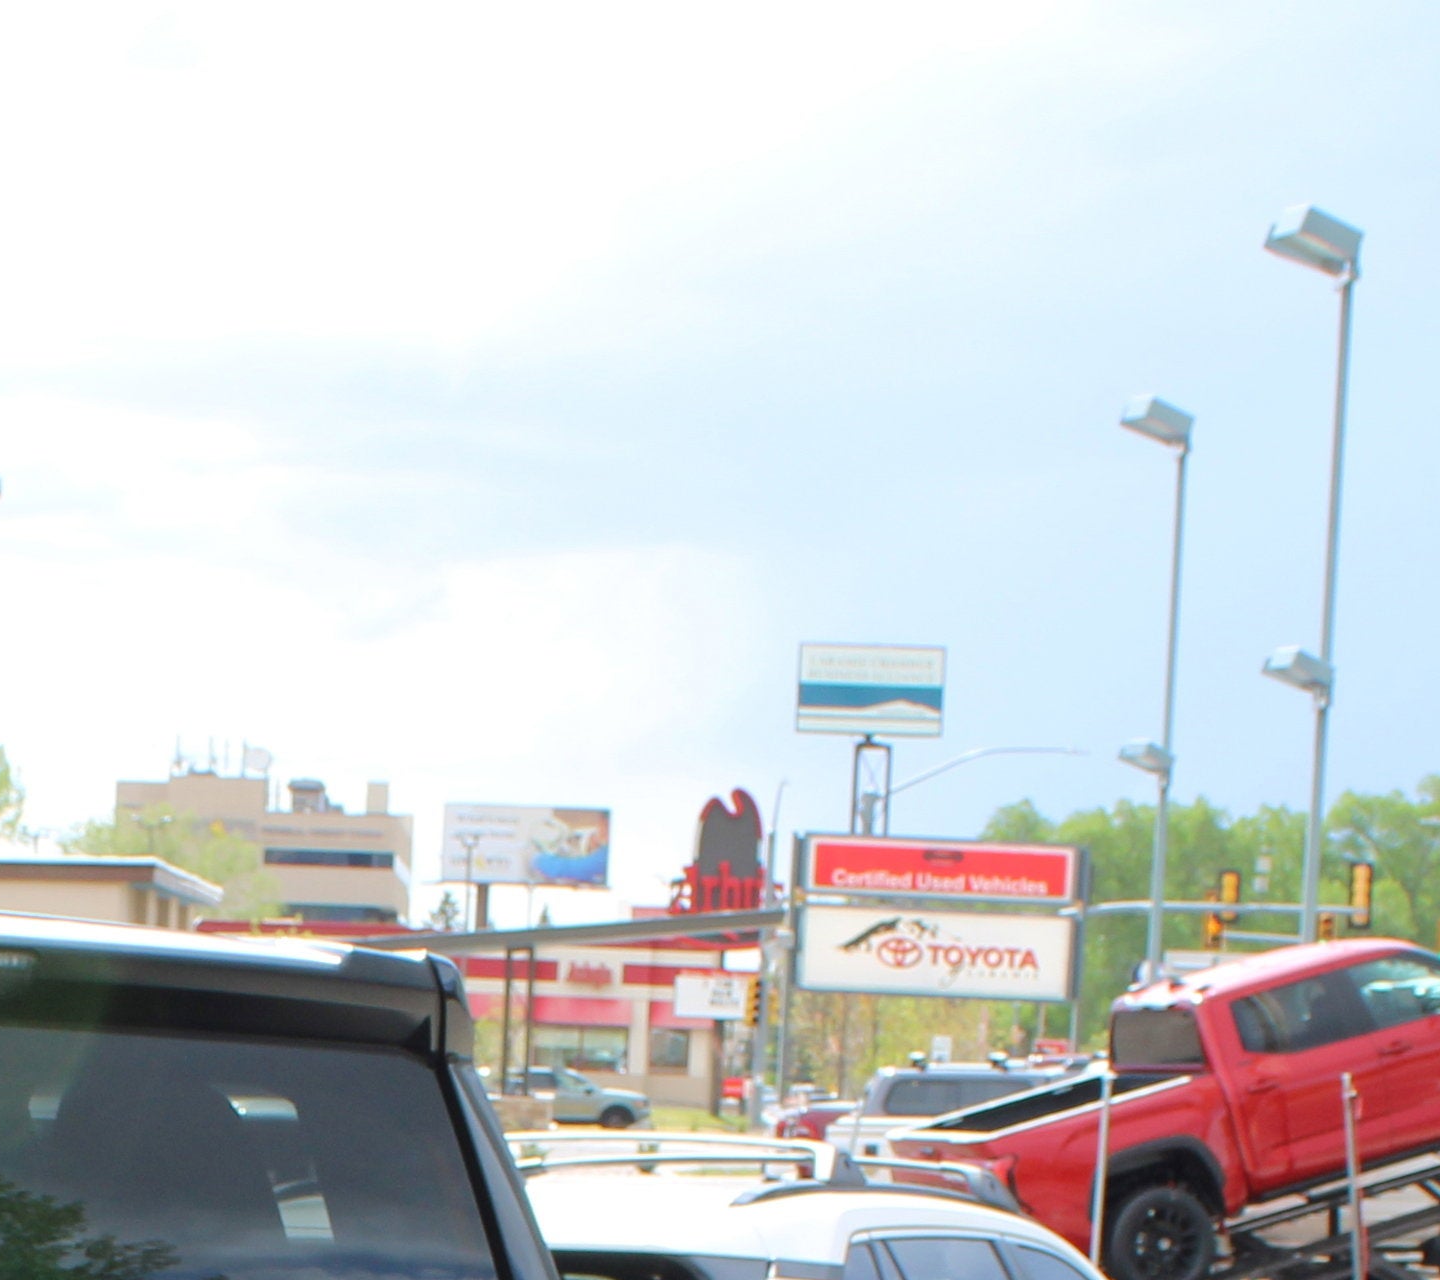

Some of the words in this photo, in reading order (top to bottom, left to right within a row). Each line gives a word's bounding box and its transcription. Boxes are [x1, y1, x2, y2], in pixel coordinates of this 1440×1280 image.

[831, 868, 912, 891] Certified
[916, 872, 966, 892] Used
[969, 874, 1049, 896] Vehicles
[925, 944, 1040, 971] TOYOTA
